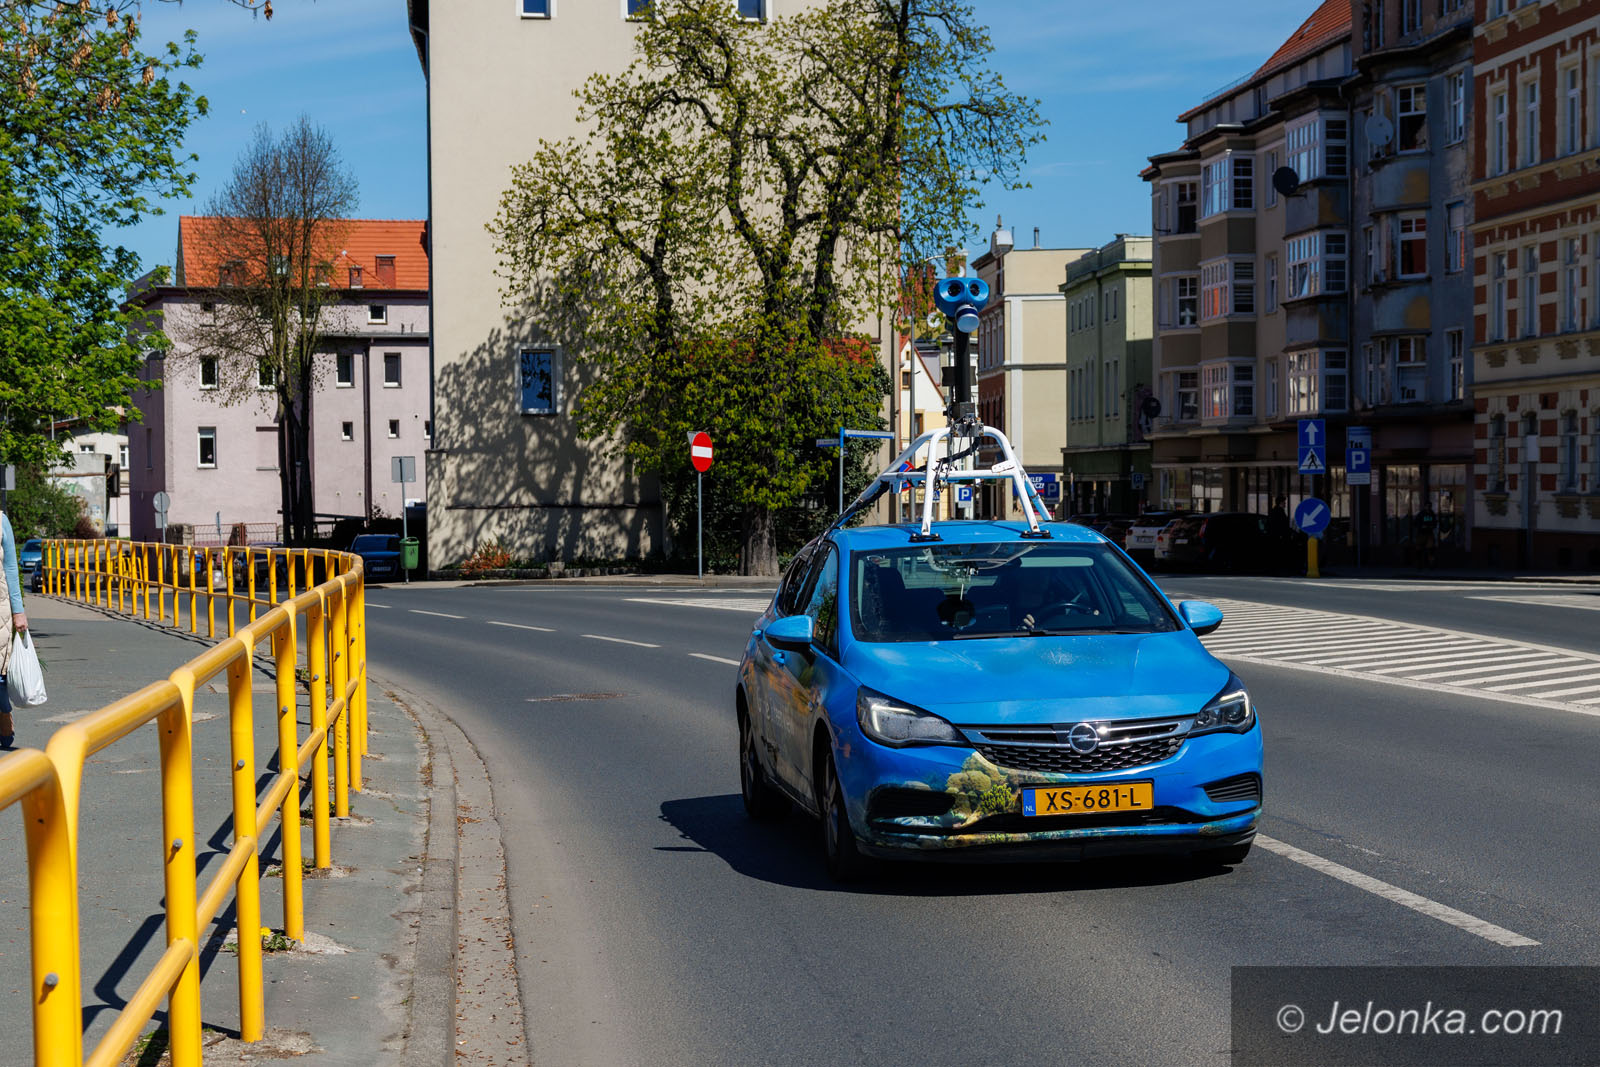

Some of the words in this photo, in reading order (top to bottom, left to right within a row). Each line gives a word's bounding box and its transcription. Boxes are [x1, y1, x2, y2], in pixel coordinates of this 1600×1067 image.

[1351, 451, 1366, 470] P
[961, 489, 970, 500] P
[1048, 483, 1057, 496] P
[1046, 787, 1142, 811] XS-681-L
